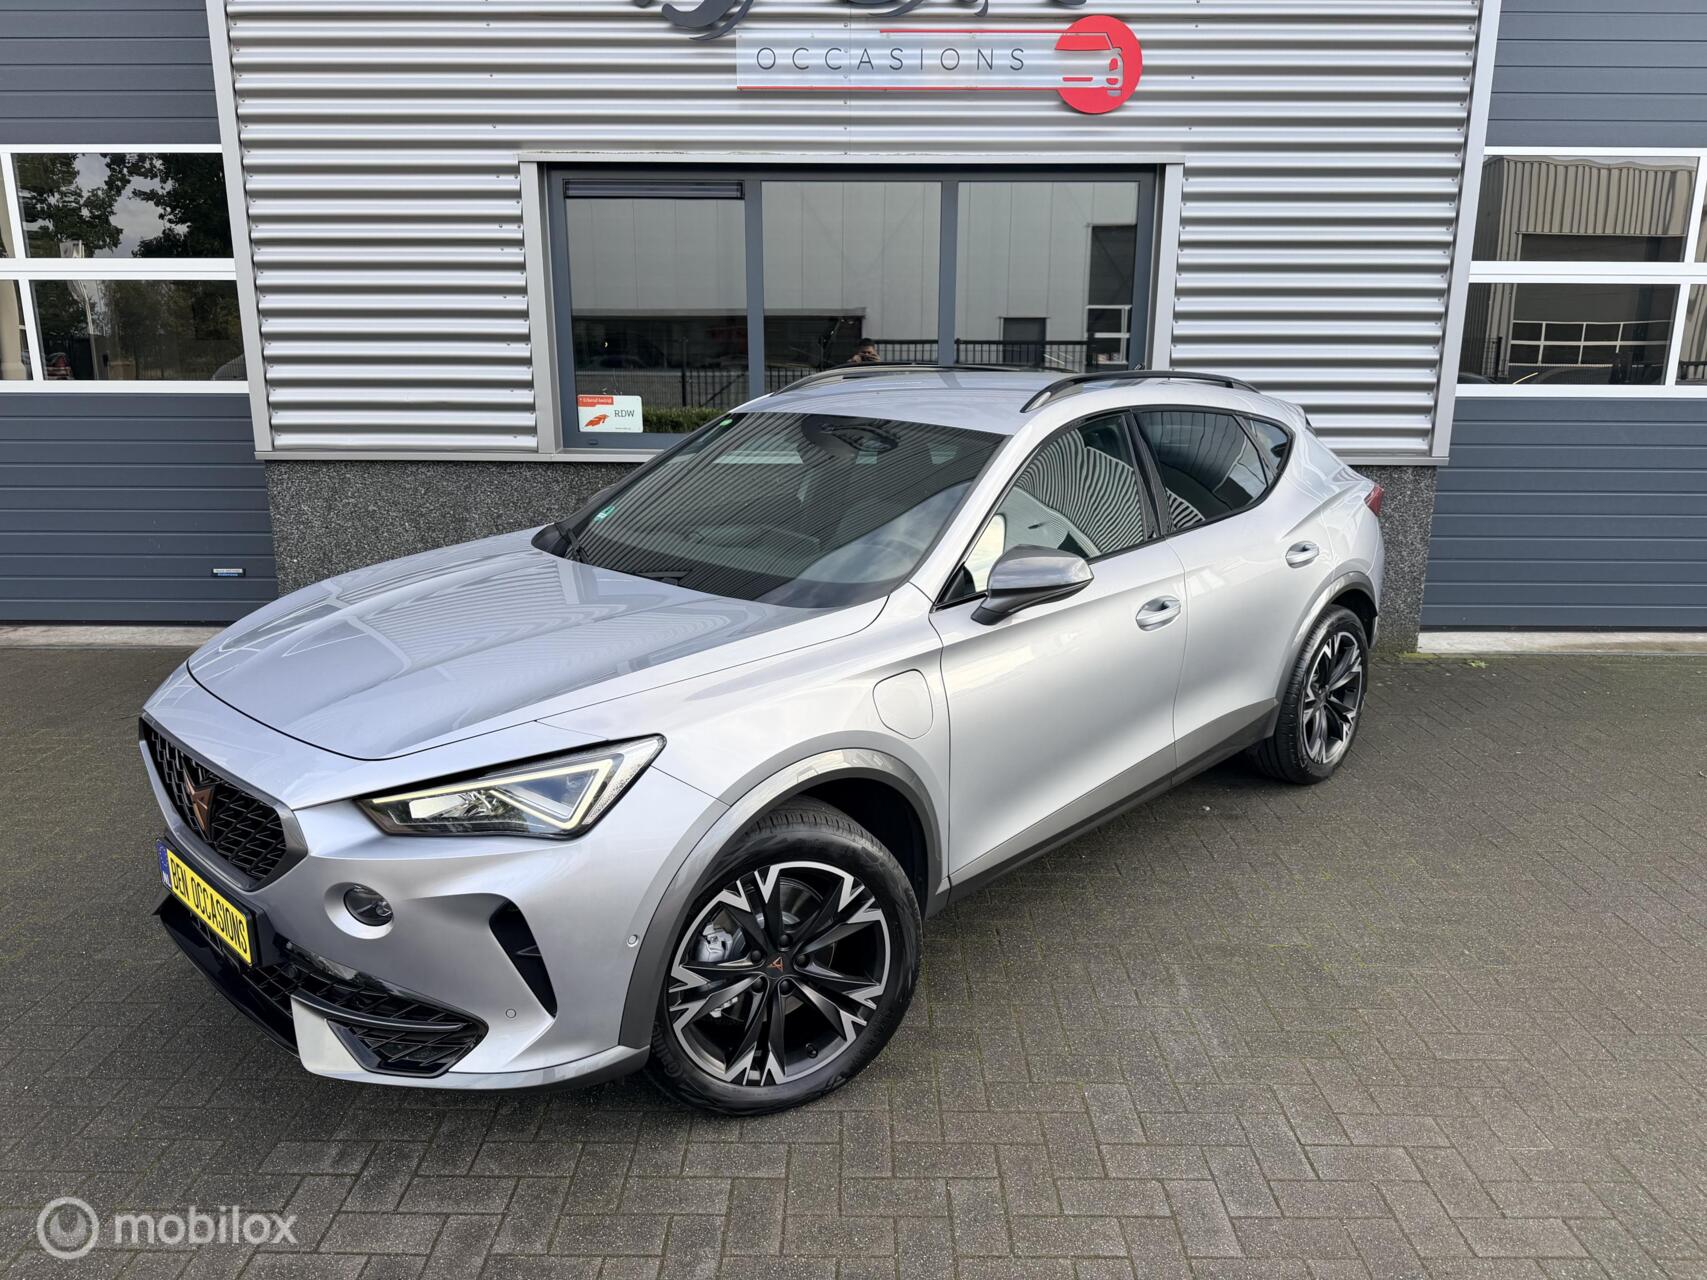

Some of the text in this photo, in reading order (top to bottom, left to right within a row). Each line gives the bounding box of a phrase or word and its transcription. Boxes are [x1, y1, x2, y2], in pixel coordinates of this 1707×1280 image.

[756, 47, 1025, 71] OCCASIONS
[614, 409, 635, 417] RDW
[170, 858, 247, 954] BEN OCCASIONS
